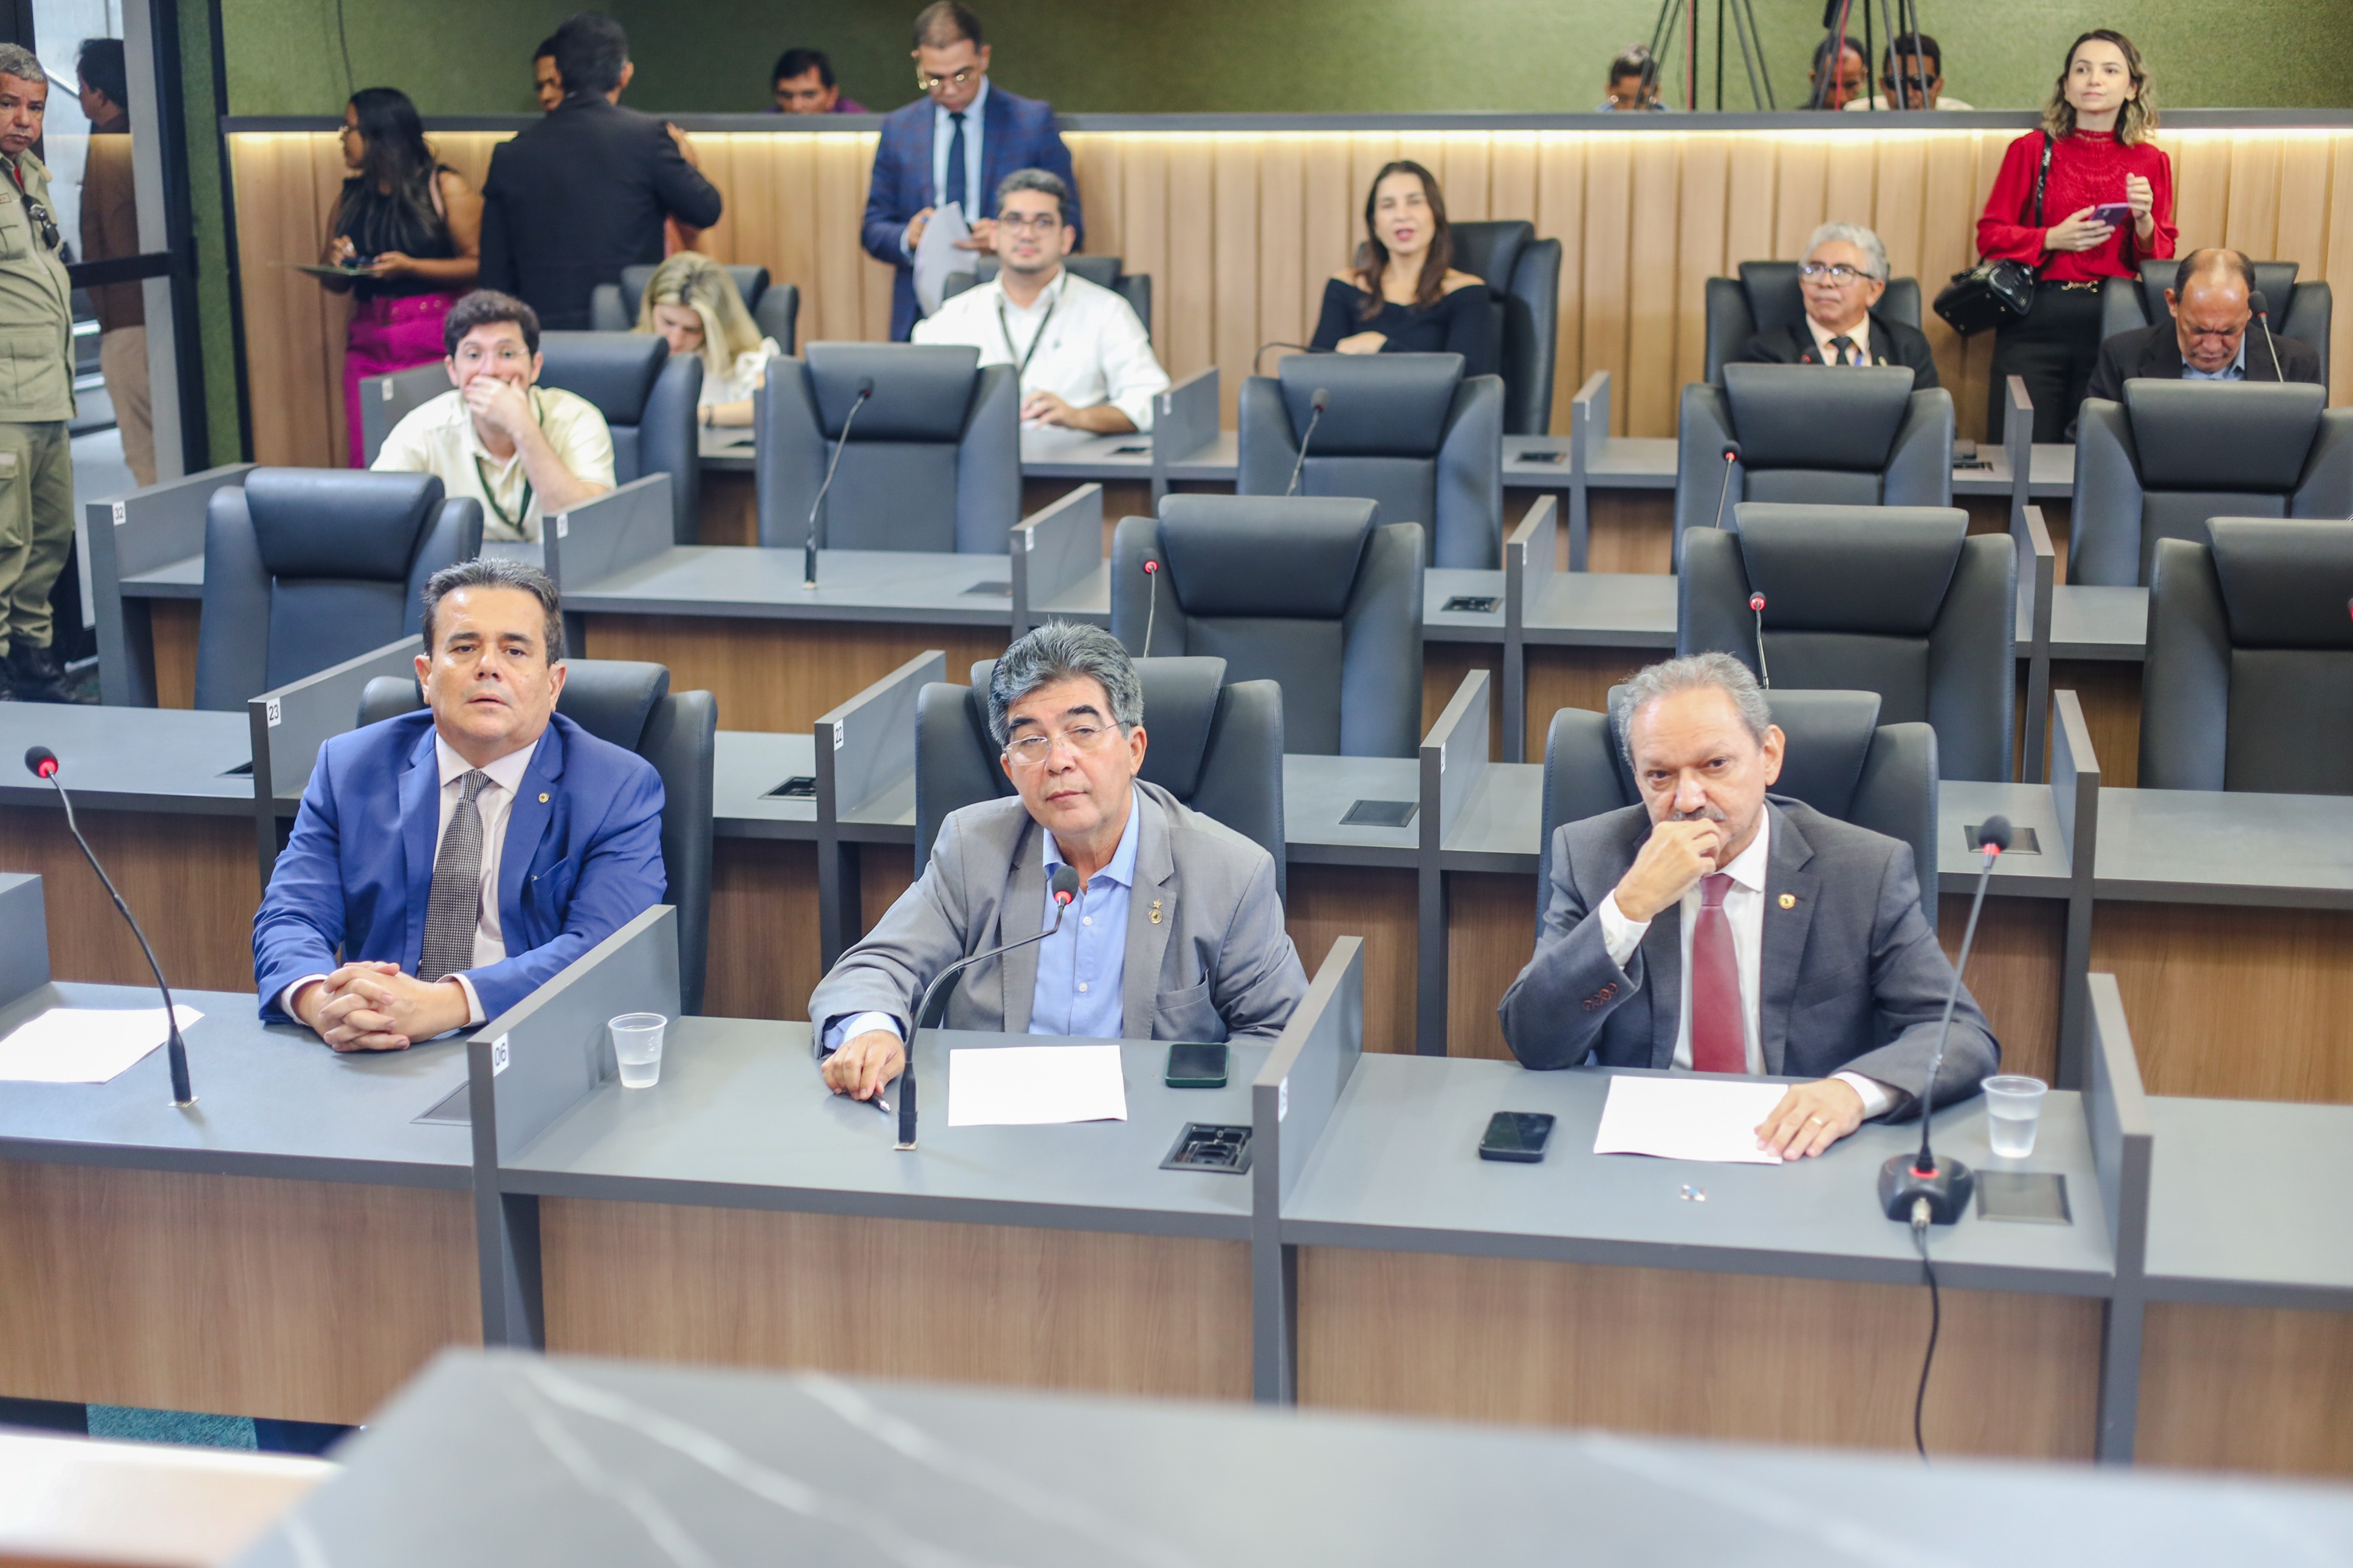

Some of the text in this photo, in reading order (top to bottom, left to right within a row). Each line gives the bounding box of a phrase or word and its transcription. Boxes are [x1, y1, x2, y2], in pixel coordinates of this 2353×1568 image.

[114, 506, 123, 520] 32
[269, 704, 279, 721] 23
[835, 726, 842, 744] 22
[495, 1042, 506, 1066] 06
